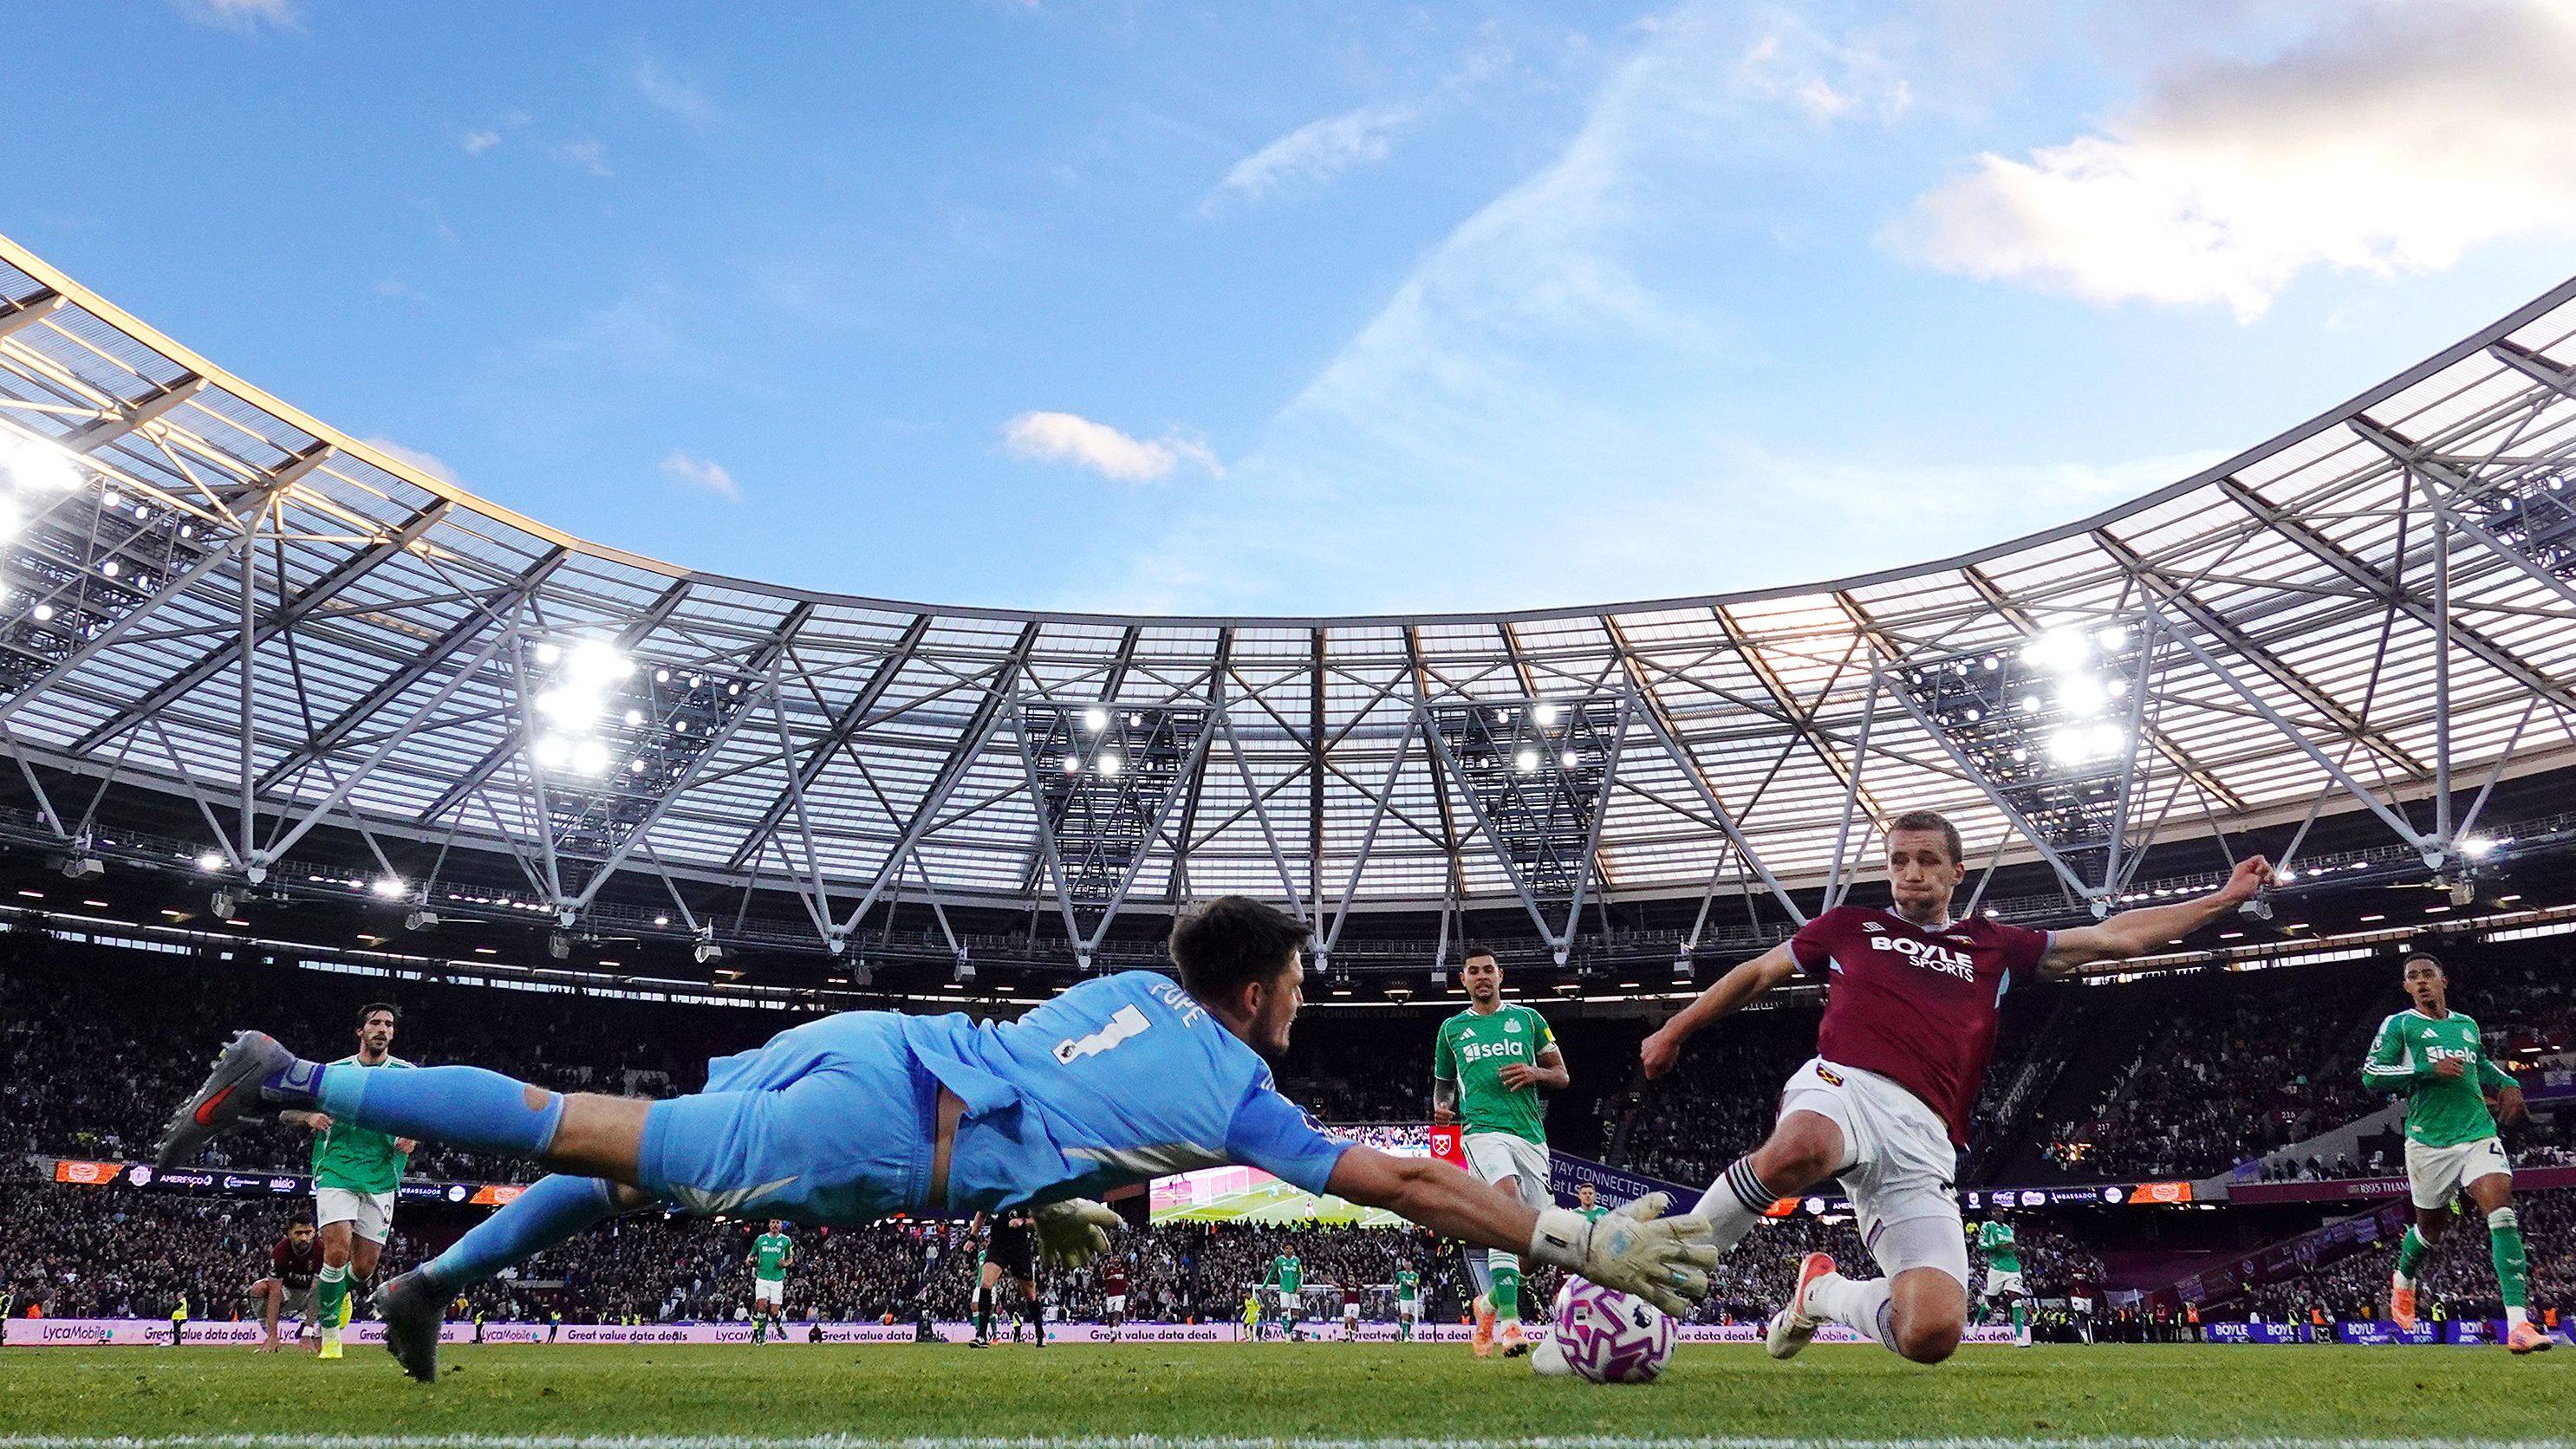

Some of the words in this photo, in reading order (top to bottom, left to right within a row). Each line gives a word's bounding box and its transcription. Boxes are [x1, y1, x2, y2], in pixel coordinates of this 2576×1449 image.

[1870, 936, 1974, 969] BOYLE
[1909, 955, 1974, 984] SPORTS
[1150, 982, 1207, 1029] POPE
[1482, 1039, 1523, 1057] sela
[2281, 1111, 2296, 1120] 216
[159, 1175, 204, 1185] AMERESCO
[1553, 1179, 1565, 1193] at
[1577, 1166, 1649, 1196] CONNECTED
[2383, 1181, 2410, 1192] THAM
[43, 1325, 106, 1342] LycaMobile
[175, 1327, 202, 1340] alue
[205, 1327, 228, 1340] data
[231, 1328, 257, 1340] deals
[1125, 1330, 1155, 1340] value
[1158, 1329, 1184, 1340] data
[1187, 1329, 1217, 1340] deals
[2215, 1324, 2247, 1335] BOYLE
[2348, 1322, 2376, 1335] BOYLE
[482, 1329, 530, 1342] LycaMobile
[568, 1330, 596, 1340] Great
[600, 1331, 627, 1340] value
[629, 1330, 655, 1341] data
[658, 1331, 687, 1341] deals
[854, 1330, 883, 1341] value
[887, 1330, 913, 1341] data
[1695, 1330, 1720, 1341] data
[1724, 1330, 1754, 1341] deals
